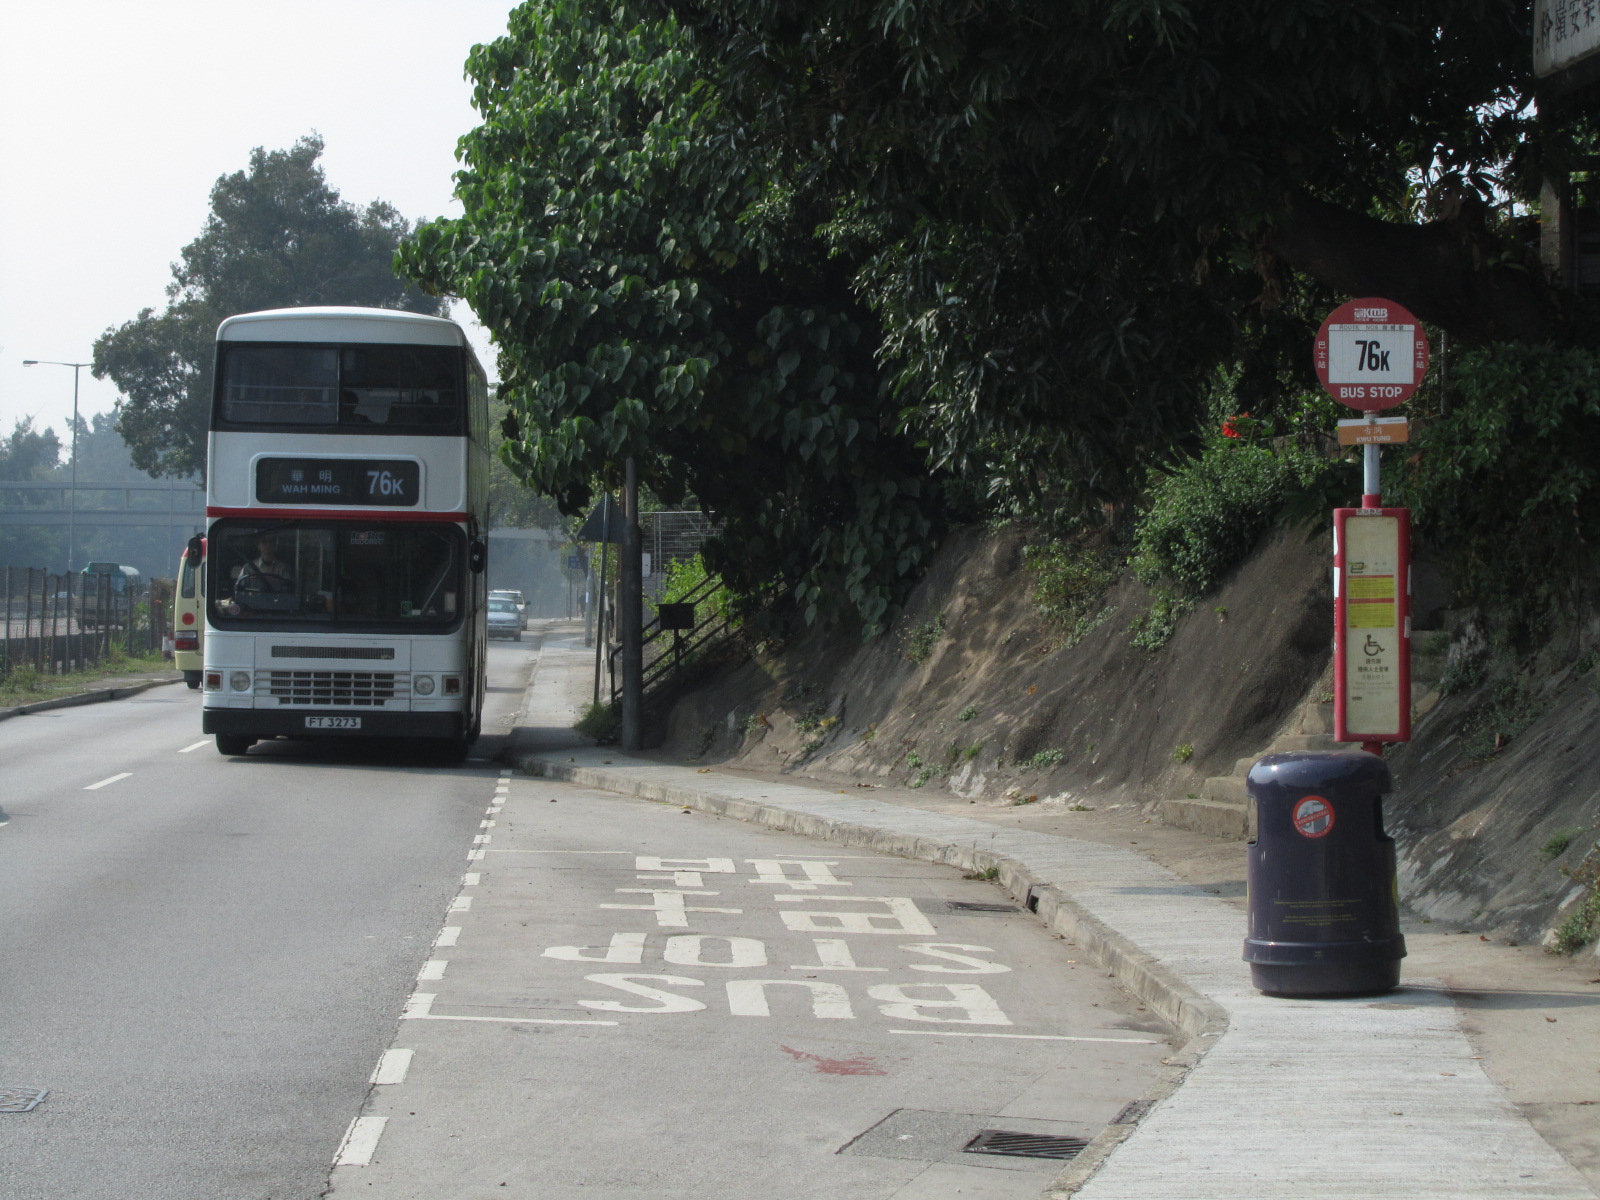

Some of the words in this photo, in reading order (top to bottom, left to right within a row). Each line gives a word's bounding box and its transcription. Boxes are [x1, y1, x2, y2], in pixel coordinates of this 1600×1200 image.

[1364, 308, 1388, 318] KMB
[1318, 341, 1326, 369] 巴士站
[1355, 340, 1390, 371] 76K
[1416, 341, 1424, 369] 巴士站
[1340, 387, 1365, 398] BUS
[1369, 387, 1403, 398] STOP
[1364, 426, 1383, 435] 古洞
[291, 470, 332, 482] 華明
[367, 471, 404, 495] 76K
[283, 485, 308, 494] WAH
[311, 485, 341, 494] MING
[309, 717, 324, 727] FT
[328, 717, 357, 727] 3273
[540, 932, 1012, 974] STOP
[576, 972, 1014, 1026] BUS
